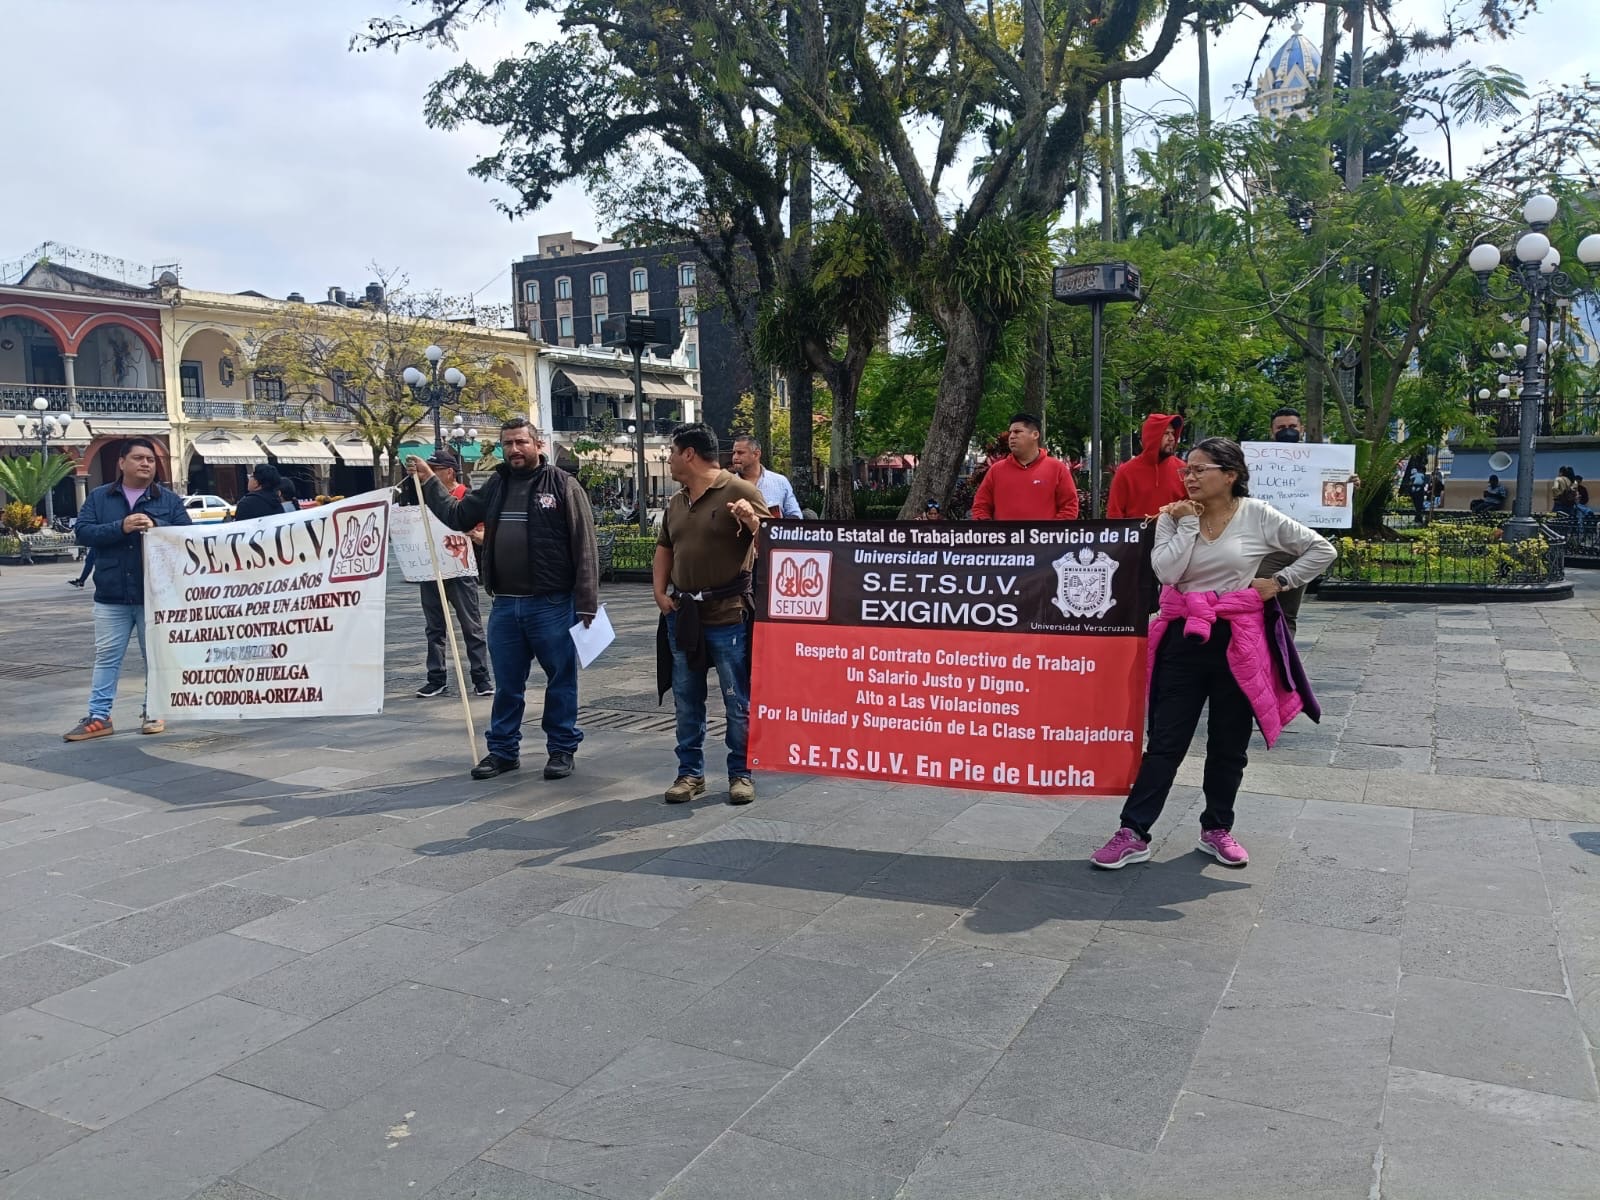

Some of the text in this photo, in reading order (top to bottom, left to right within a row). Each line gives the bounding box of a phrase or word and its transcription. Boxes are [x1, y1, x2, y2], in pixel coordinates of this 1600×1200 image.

[183, 516, 334, 576] S.E.T.S.U.V.
[769, 526, 1140, 547] Sindicato Estatal de Trabajadores al Servicio de la
[333, 556, 377, 576] SETSUV
[854, 549, 1036, 567] Universidad Veracruzana
[185, 572, 323, 602] COMO TODOS LOS AÑOS
[862, 572, 1021, 597] S.E.T.S.U.V.
[154, 590, 361, 625] EN PIE DE LUCHA POR UN AUMENTO
[775, 600, 823, 615] SETSUV
[861, 599, 1019, 627] EXIGIMOS
[168, 616, 334, 644] SALARIAL Y CONTRACTUAL
[1030, 622, 1135, 633] Universidad Veracruzana
[795, 642, 1096, 675] Respeto al Contrato Colectivo de Trabajo
[182, 664, 310, 685] SOLUCIÓN O HUELGA
[847, 667, 1031, 695] Un Salario Justo y Digno.
[170, 686, 324, 707] ZONA: CORDOBA-ORIZABA
[856, 690, 1020, 716] Alto a Las Violaciones
[758, 705, 1134, 745] Por la Unidad y Superación de La Clase Trabajadora
[789, 743, 1095, 787] S.E.T.S.U.V. En Pie de Lucha
